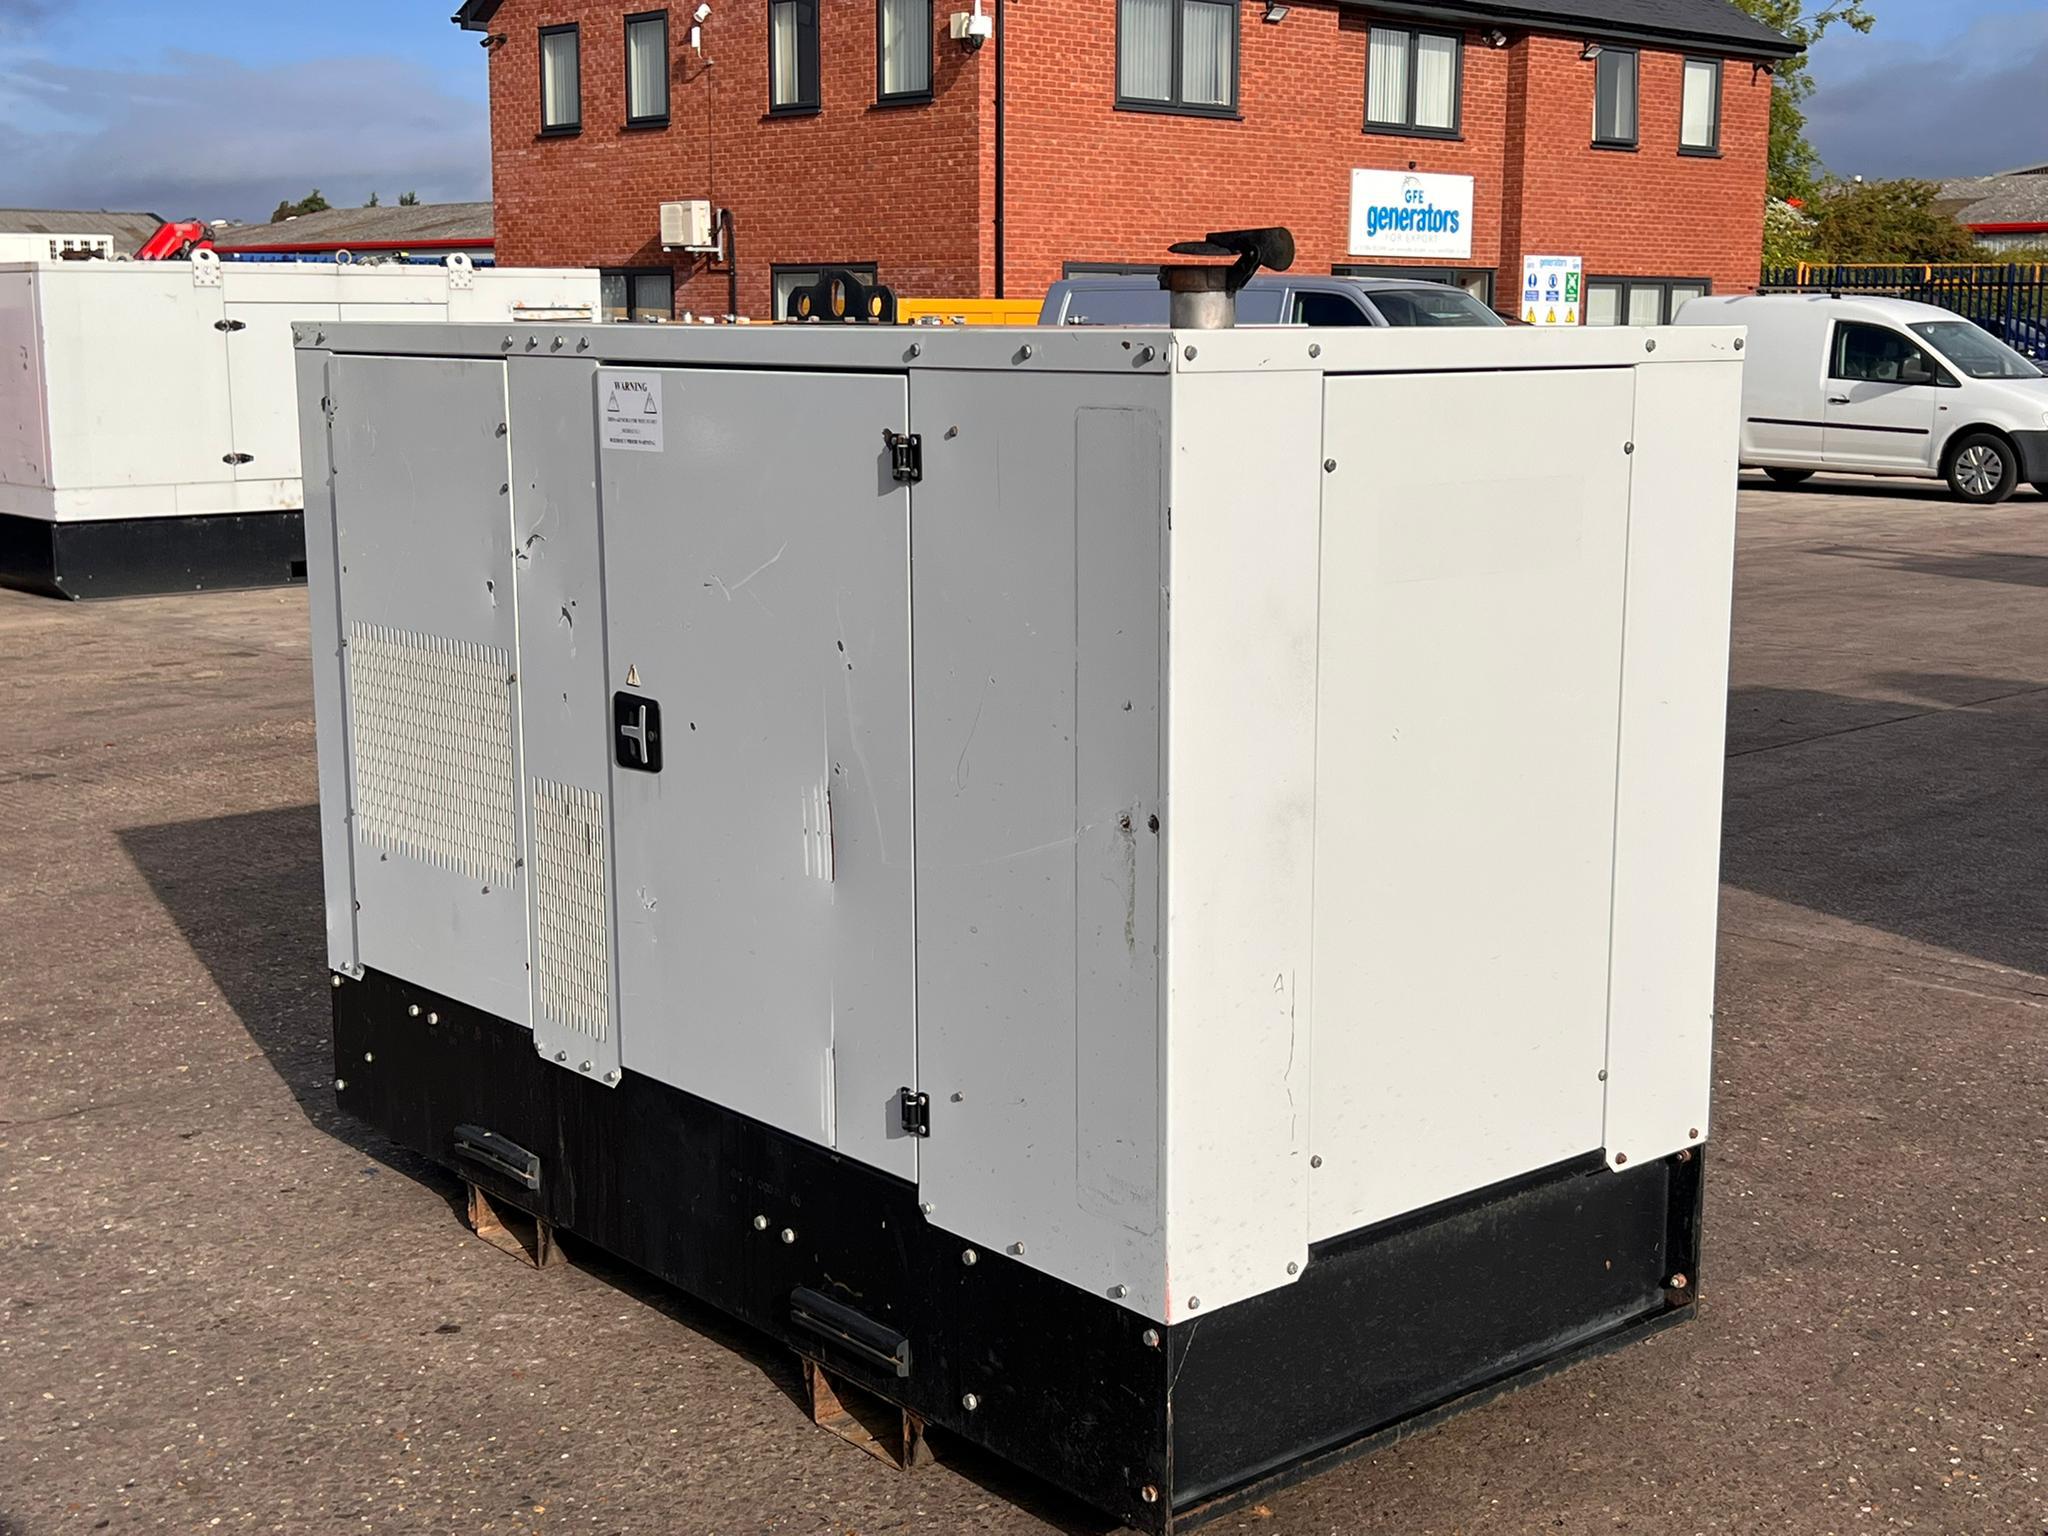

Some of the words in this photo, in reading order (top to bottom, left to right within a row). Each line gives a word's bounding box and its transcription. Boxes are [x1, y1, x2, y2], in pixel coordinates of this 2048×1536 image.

[1405, 189, 1424, 204] GFE
[1367, 203, 1460, 237] generators
[614, 381, 648, 392] WARNING
